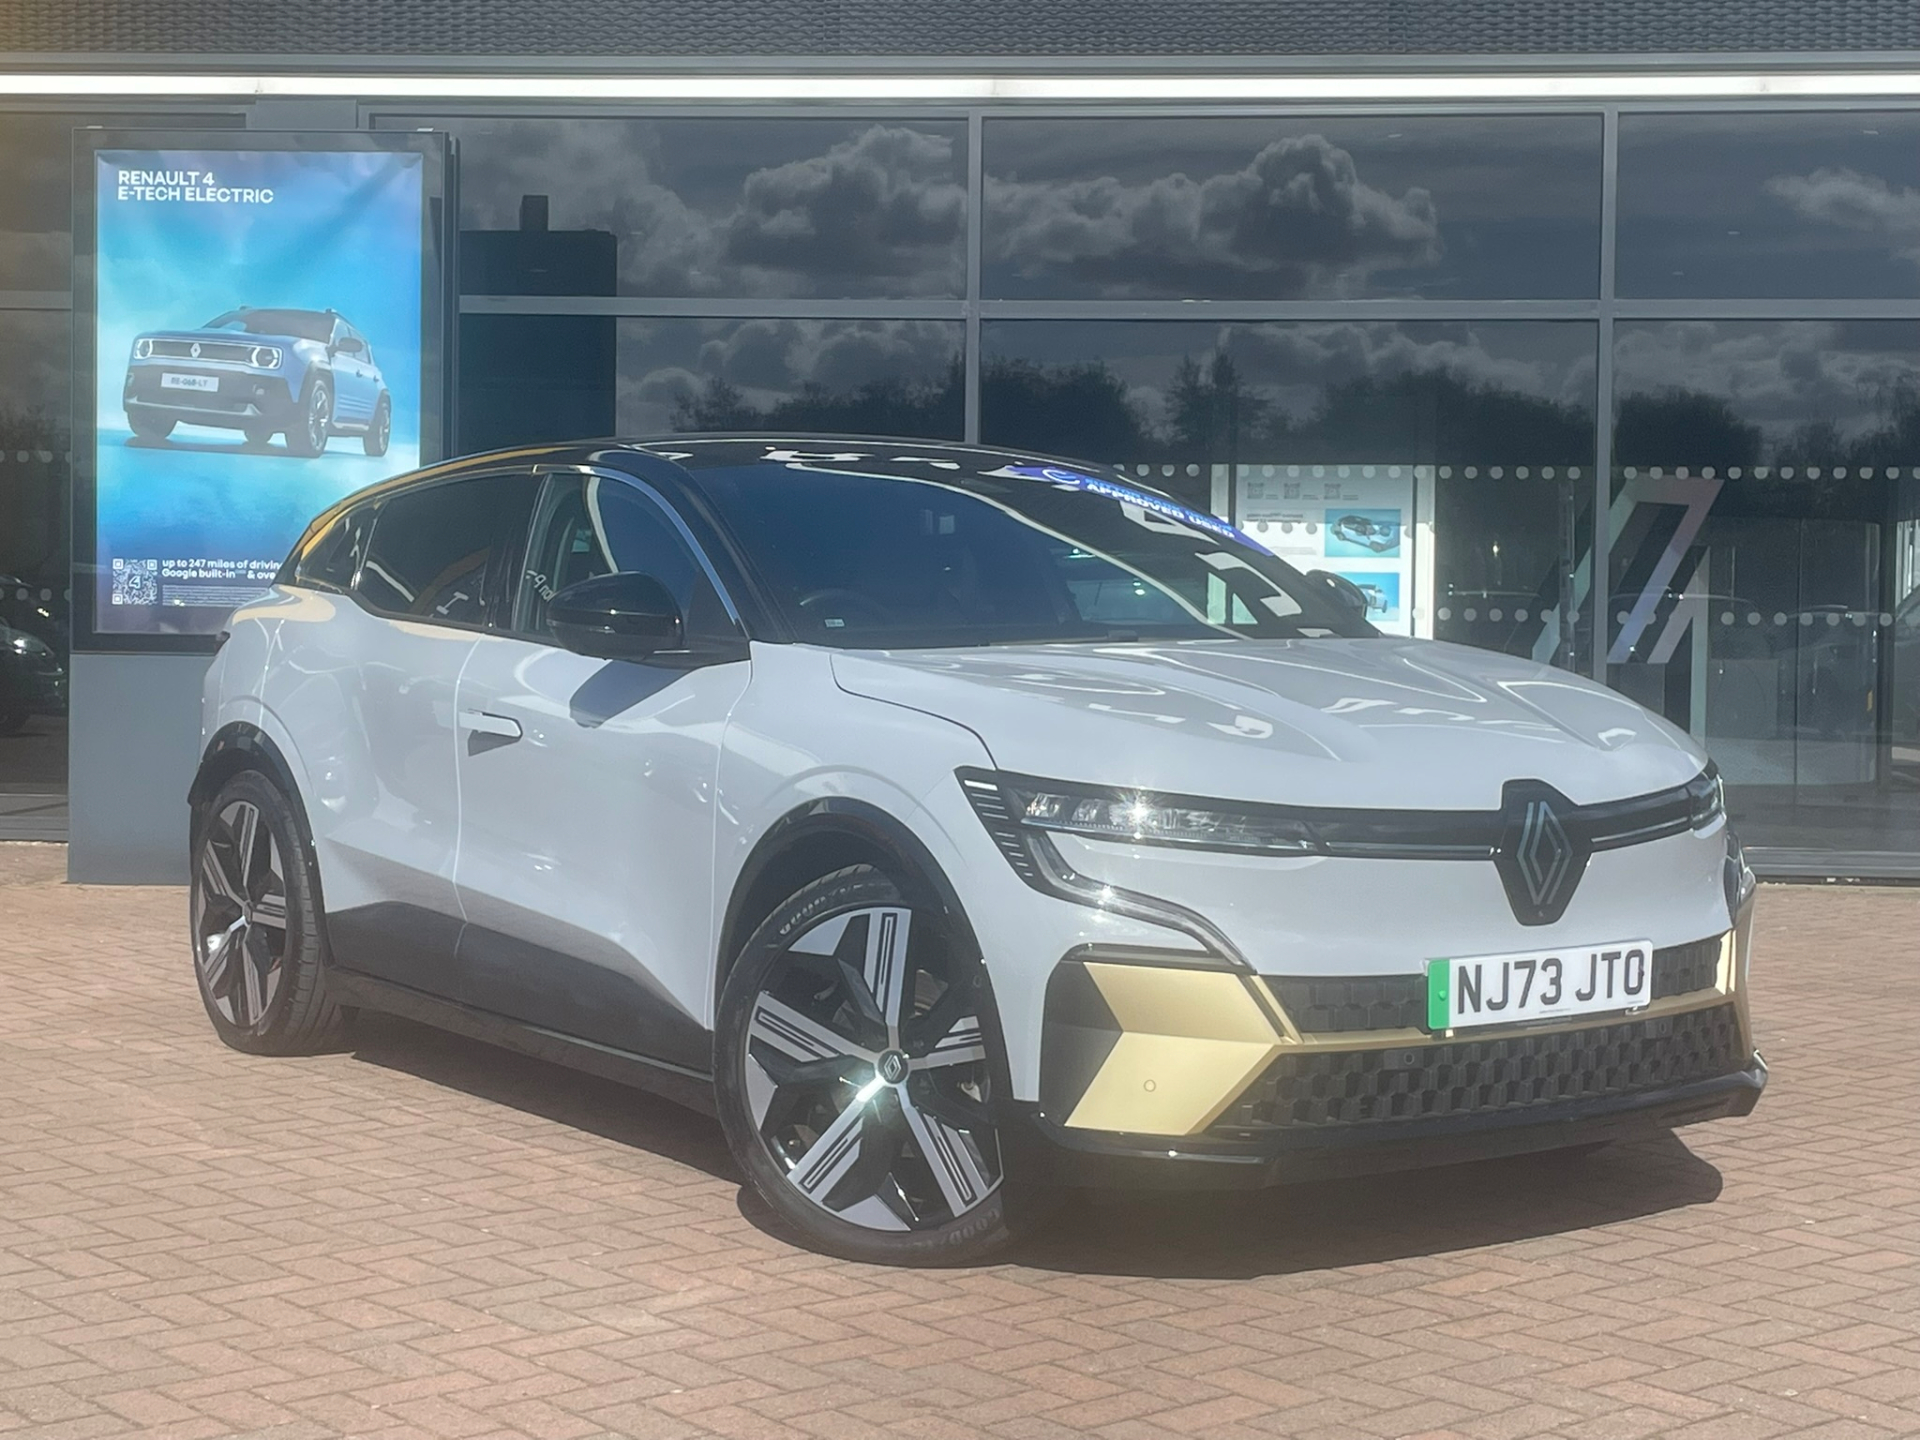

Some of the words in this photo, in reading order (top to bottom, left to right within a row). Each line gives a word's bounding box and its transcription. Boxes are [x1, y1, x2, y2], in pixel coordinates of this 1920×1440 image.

[118, 170, 200, 186] RENAULT
[202, 172, 215, 187] 4
[117, 186, 181, 202] E-TECH
[184, 187, 274, 204] ELECTRIC
[1086, 483, 1185, 519] APPROVED
[1188, 516, 1235, 539] USED
[162, 560, 175, 569] up
[176, 560, 188, 568] to
[189, 559, 206, 568] 247
[207, 559, 235, 569] miles
[236, 560, 248, 569] of
[249, 560, 282, 570] drivin
[162, 569, 197, 580] Google
[198, 569, 236, 579] built-in
[247, 570, 256, 580] &
[257, 571, 276, 580] ove
[1457, 957, 1563, 1015] NJ73
